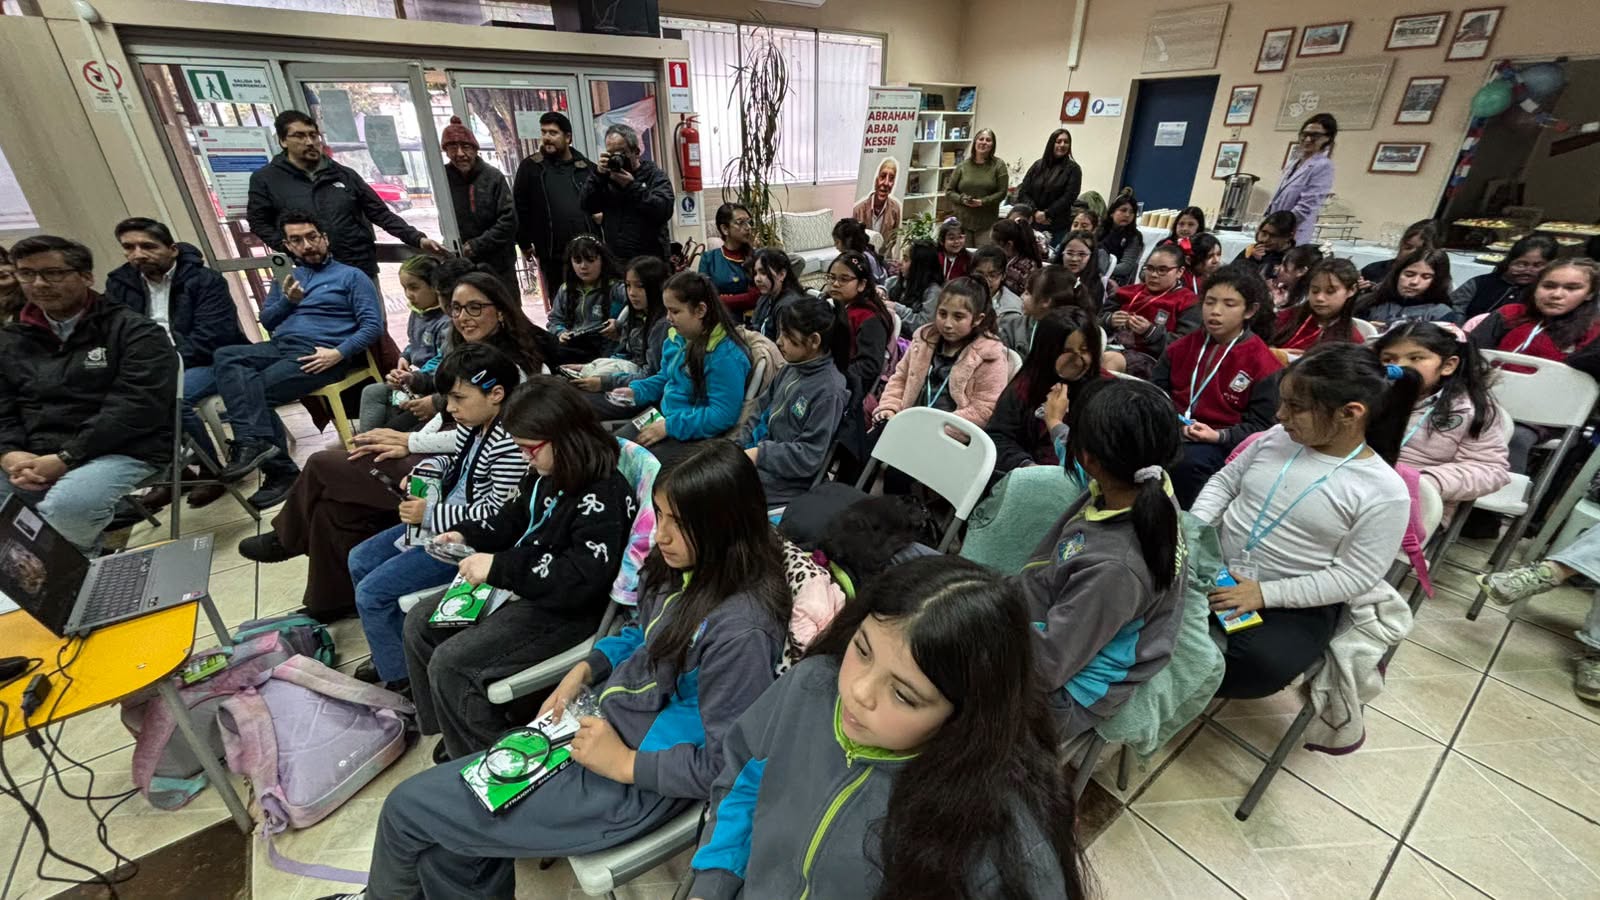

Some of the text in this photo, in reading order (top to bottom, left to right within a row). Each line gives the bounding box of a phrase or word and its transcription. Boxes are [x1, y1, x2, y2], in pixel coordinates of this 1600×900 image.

[868, 111, 916, 121] ABRAHAM
[866, 124, 899, 134] ABARA
[865, 136, 896, 147] KESSIE
